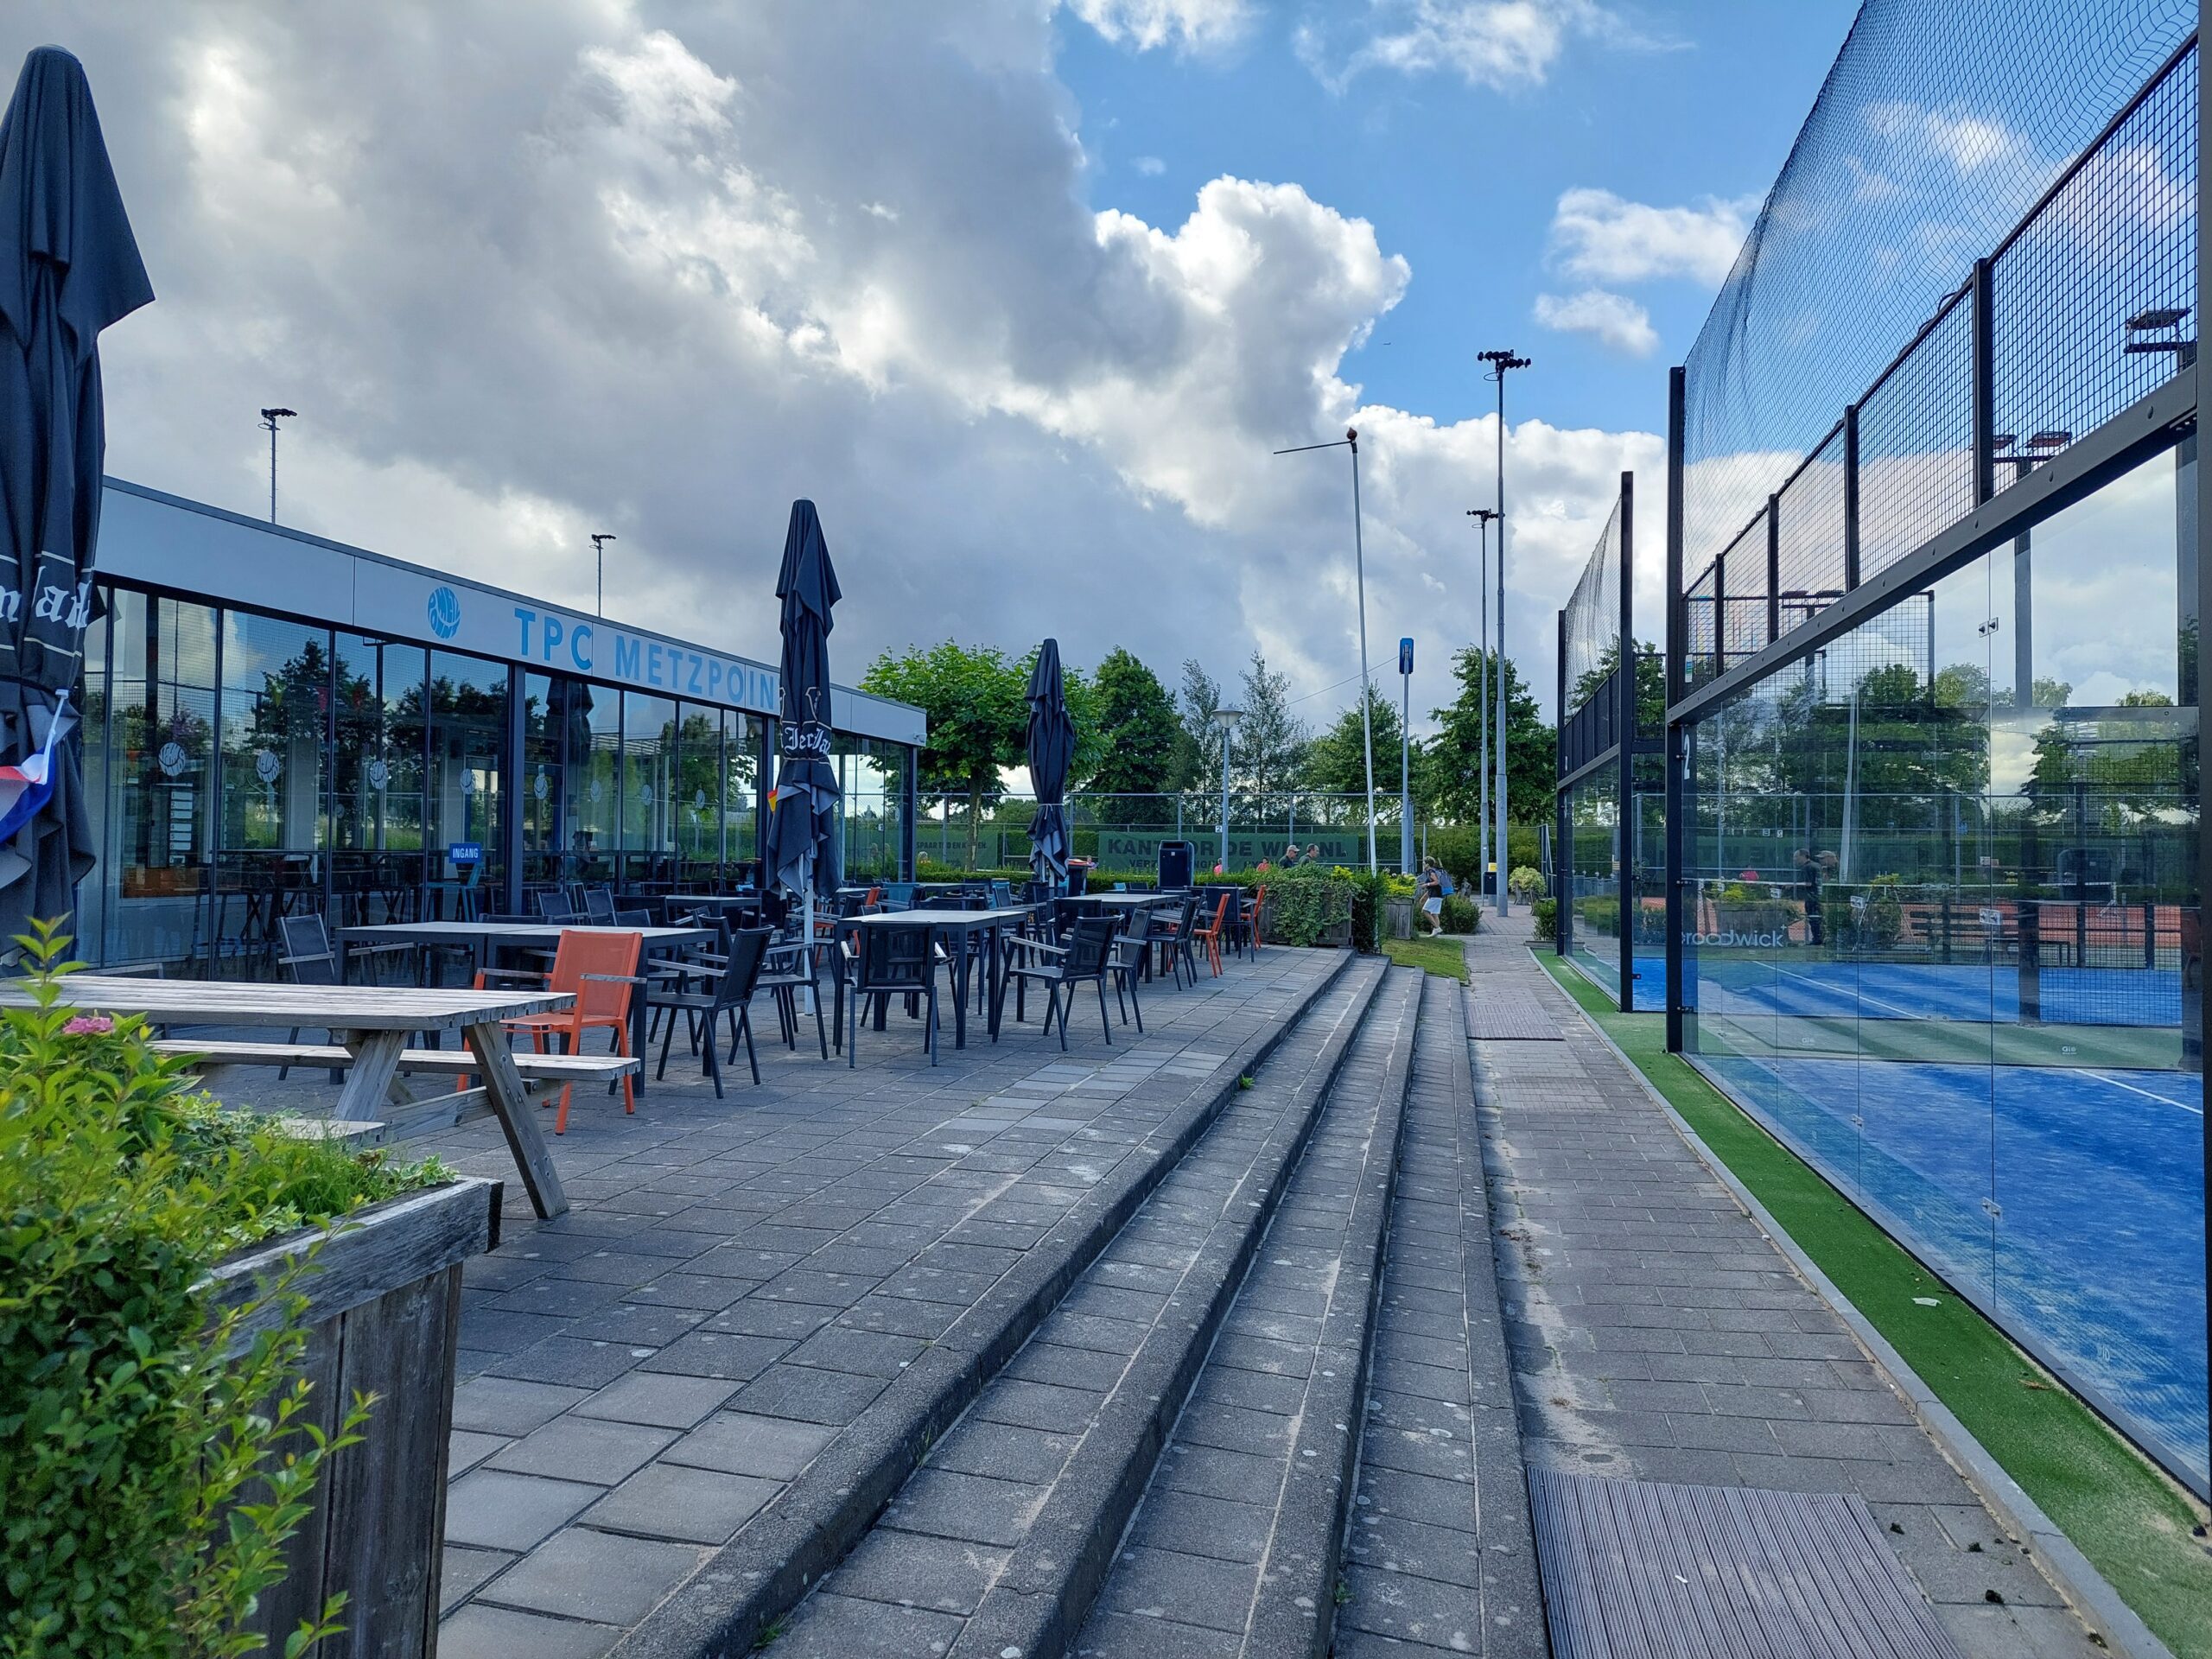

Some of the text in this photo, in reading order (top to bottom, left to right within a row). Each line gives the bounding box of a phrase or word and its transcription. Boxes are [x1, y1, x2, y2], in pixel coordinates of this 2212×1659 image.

[514, 607, 775, 710] TPC METZPOIN
[1683, 734, 1690, 779] 2
[452, 848, 479, 858] INGANG
